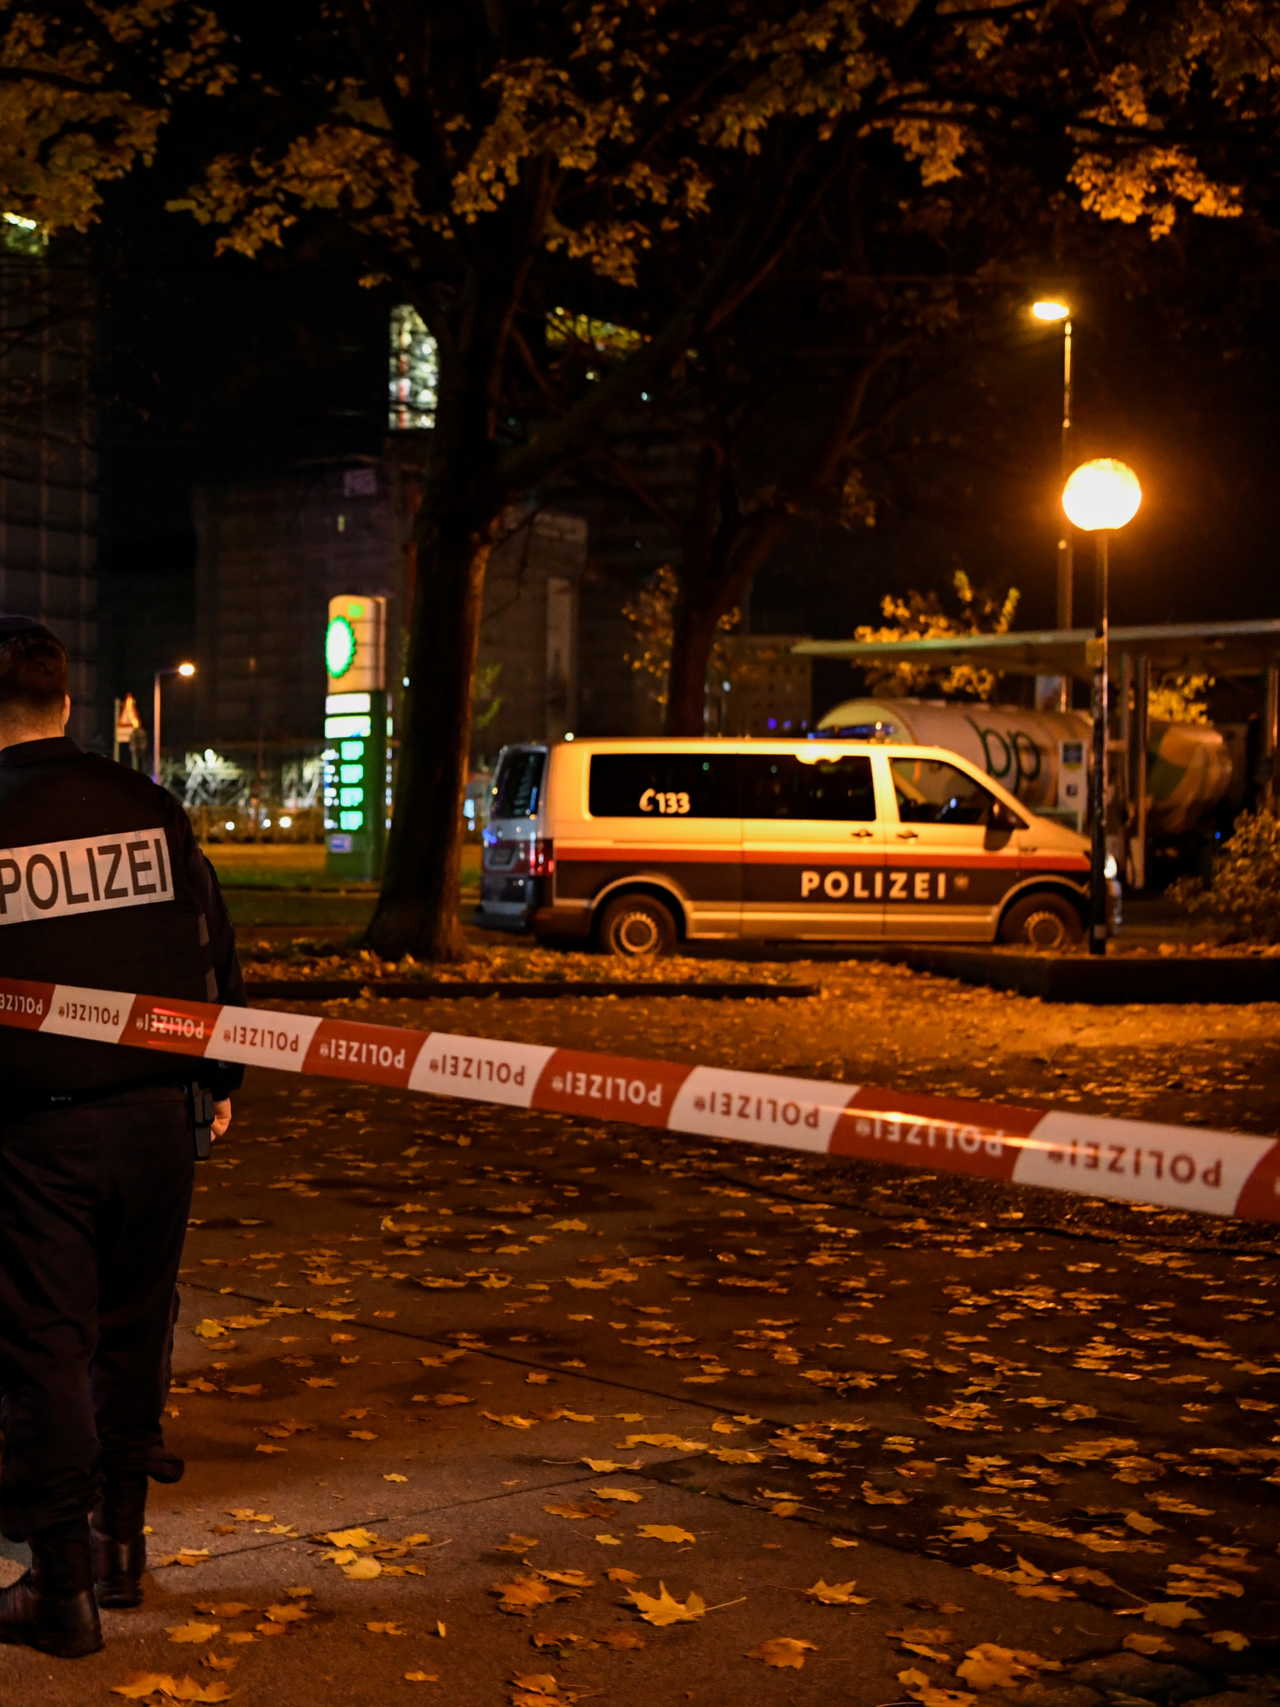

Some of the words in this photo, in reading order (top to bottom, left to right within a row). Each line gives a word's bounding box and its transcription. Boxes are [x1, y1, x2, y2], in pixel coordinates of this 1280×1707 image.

[964, 714, 1041, 795] bp
[655, 791, 691, 814] 133
[801, 870, 946, 900] POLIZEI
[65, 1002, 119, 1026] POLIZEI
[144, 1013, 205, 1039] POLIZEI
[232, 1026, 299, 1051] POLIZEI
[330, 1038, 406, 1069] POLIZEI
[442, 1055, 525, 1086] POLIZEI
[565, 1071, 663, 1107] POLIZEI
[710, 1092, 819, 1129] POLIZEI
[1071, 1140, 1221, 1188] POLIZEI
